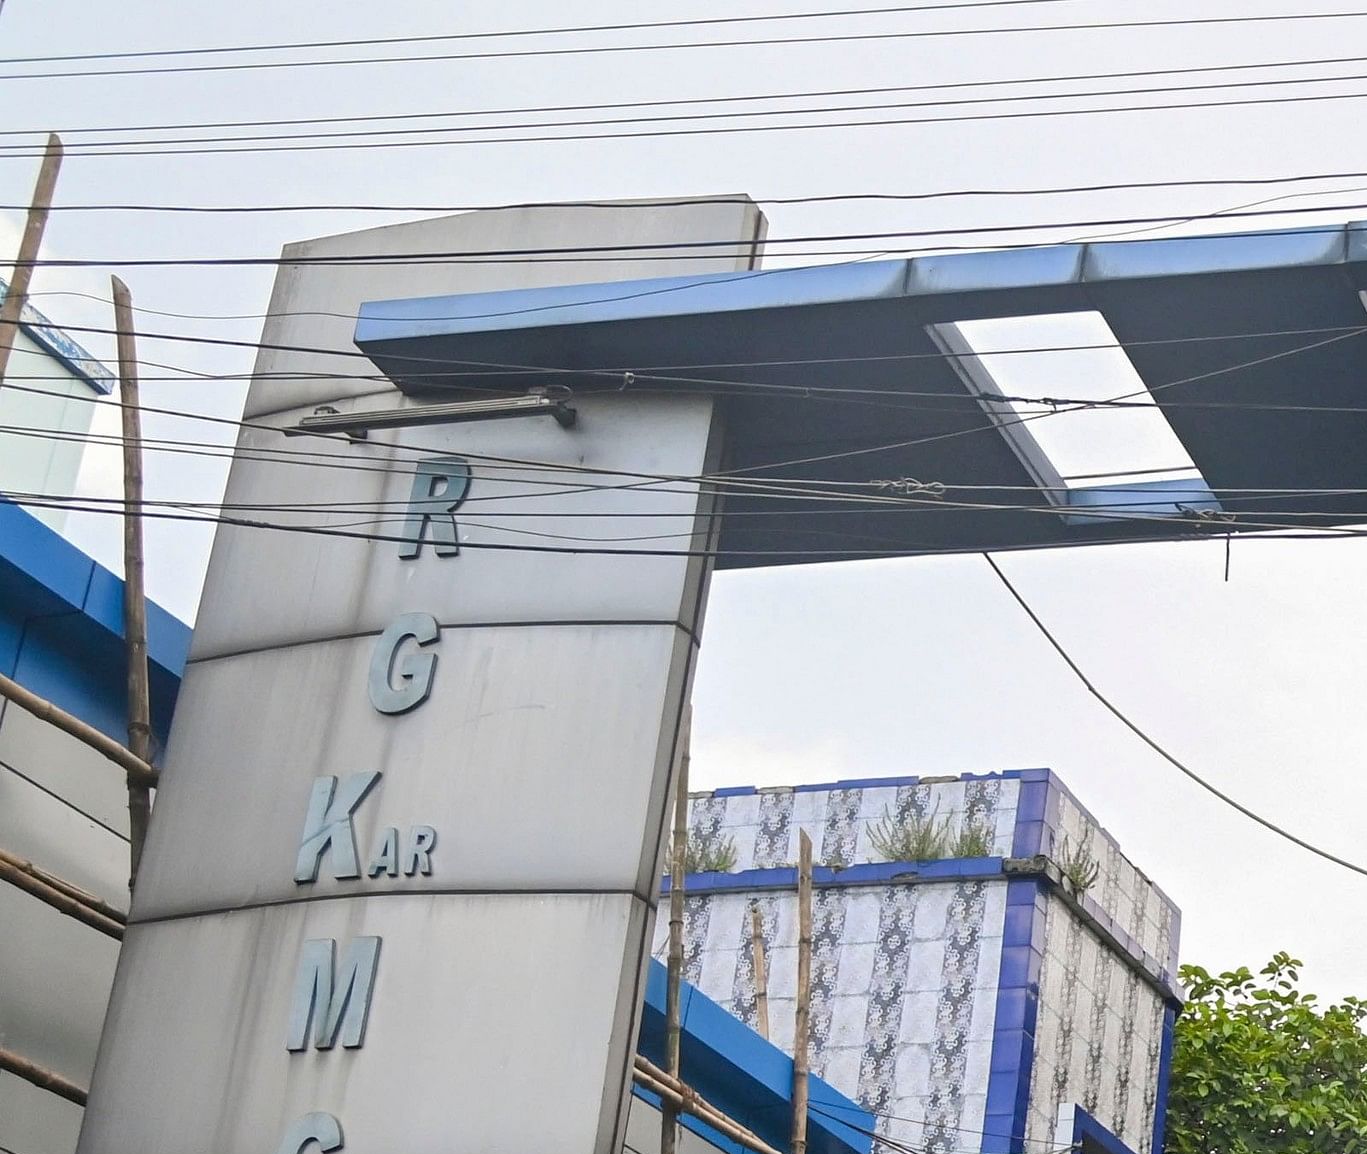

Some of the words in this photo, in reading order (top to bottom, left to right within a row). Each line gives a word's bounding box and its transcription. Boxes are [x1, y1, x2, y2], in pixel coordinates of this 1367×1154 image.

[398, 456, 472, 560] R
[367, 611, 441, 716] G
[286, 935, 383, 1053] M
